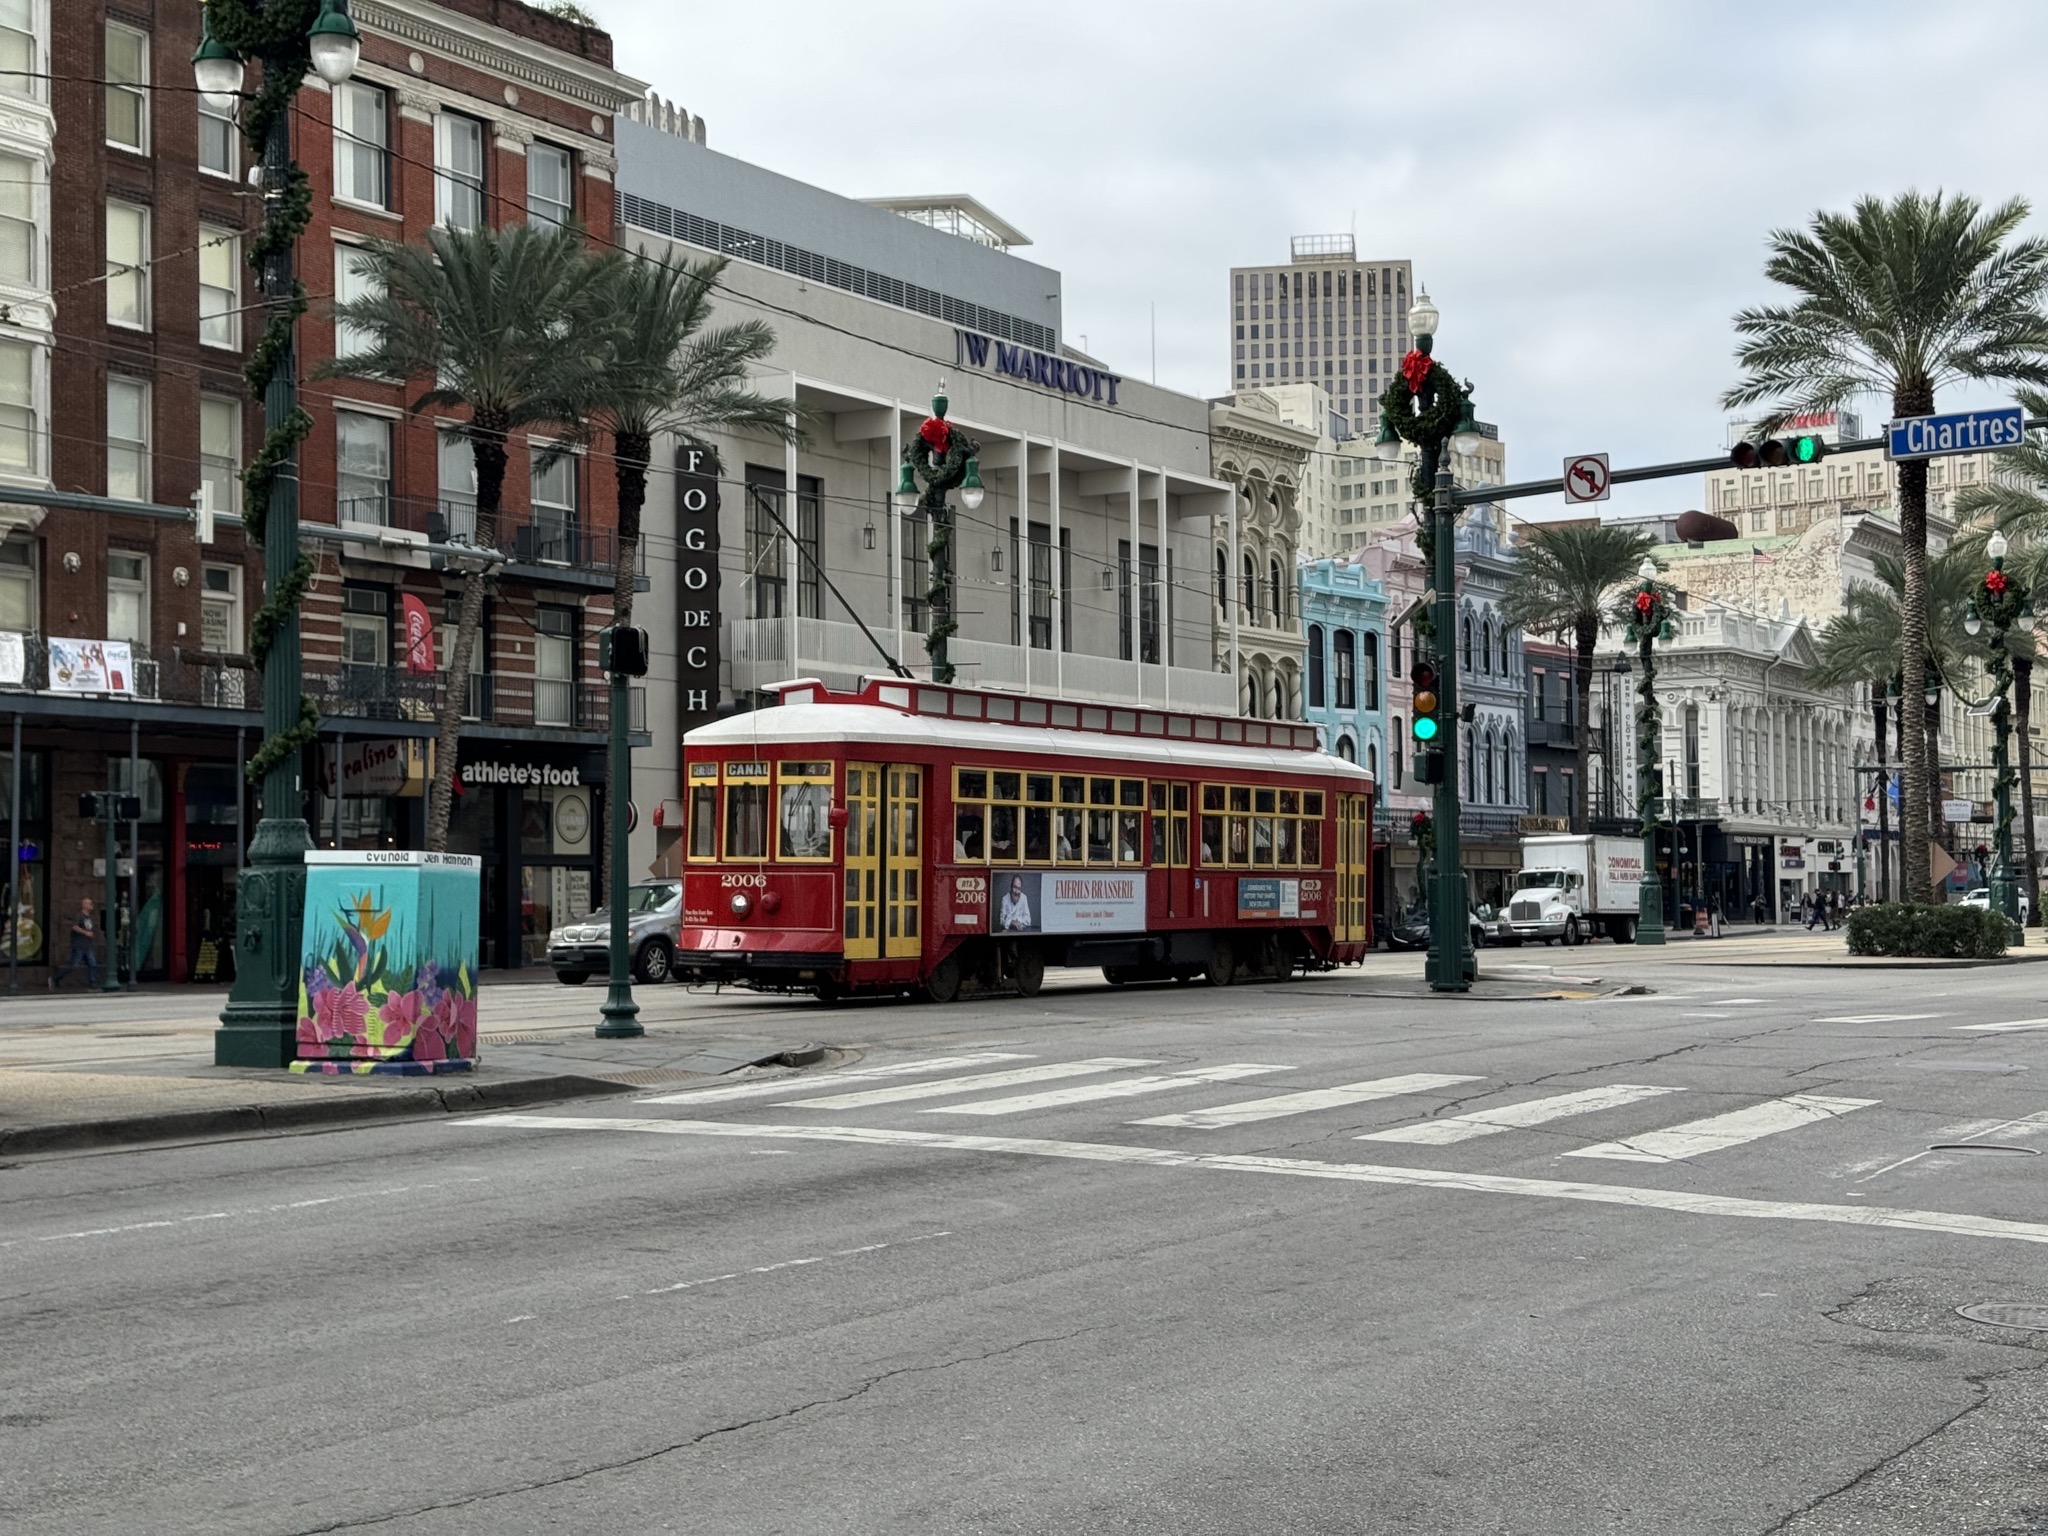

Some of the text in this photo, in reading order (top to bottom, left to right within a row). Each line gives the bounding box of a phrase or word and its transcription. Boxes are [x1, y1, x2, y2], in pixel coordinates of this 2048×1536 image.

[954, 328, 1122, 405] JW MARRIOTT
[1907, 414, 2020, 452] Chartres
[684, 450, 707, 590] FOGO
[201, 617, 228, 627] EASING
[684, 610, 711, 627] DE
[462, 761, 580, 786] athlete's foot
[728, 764, 768, 775] CANAL
[721, 874, 767, 888] 2006
[961, 879, 973, 888] RTA
[1091, 879, 1135, 899] BRASSERIE
[1301, 891, 1322, 901] 2006
[955, 891, 986, 904] 2006
